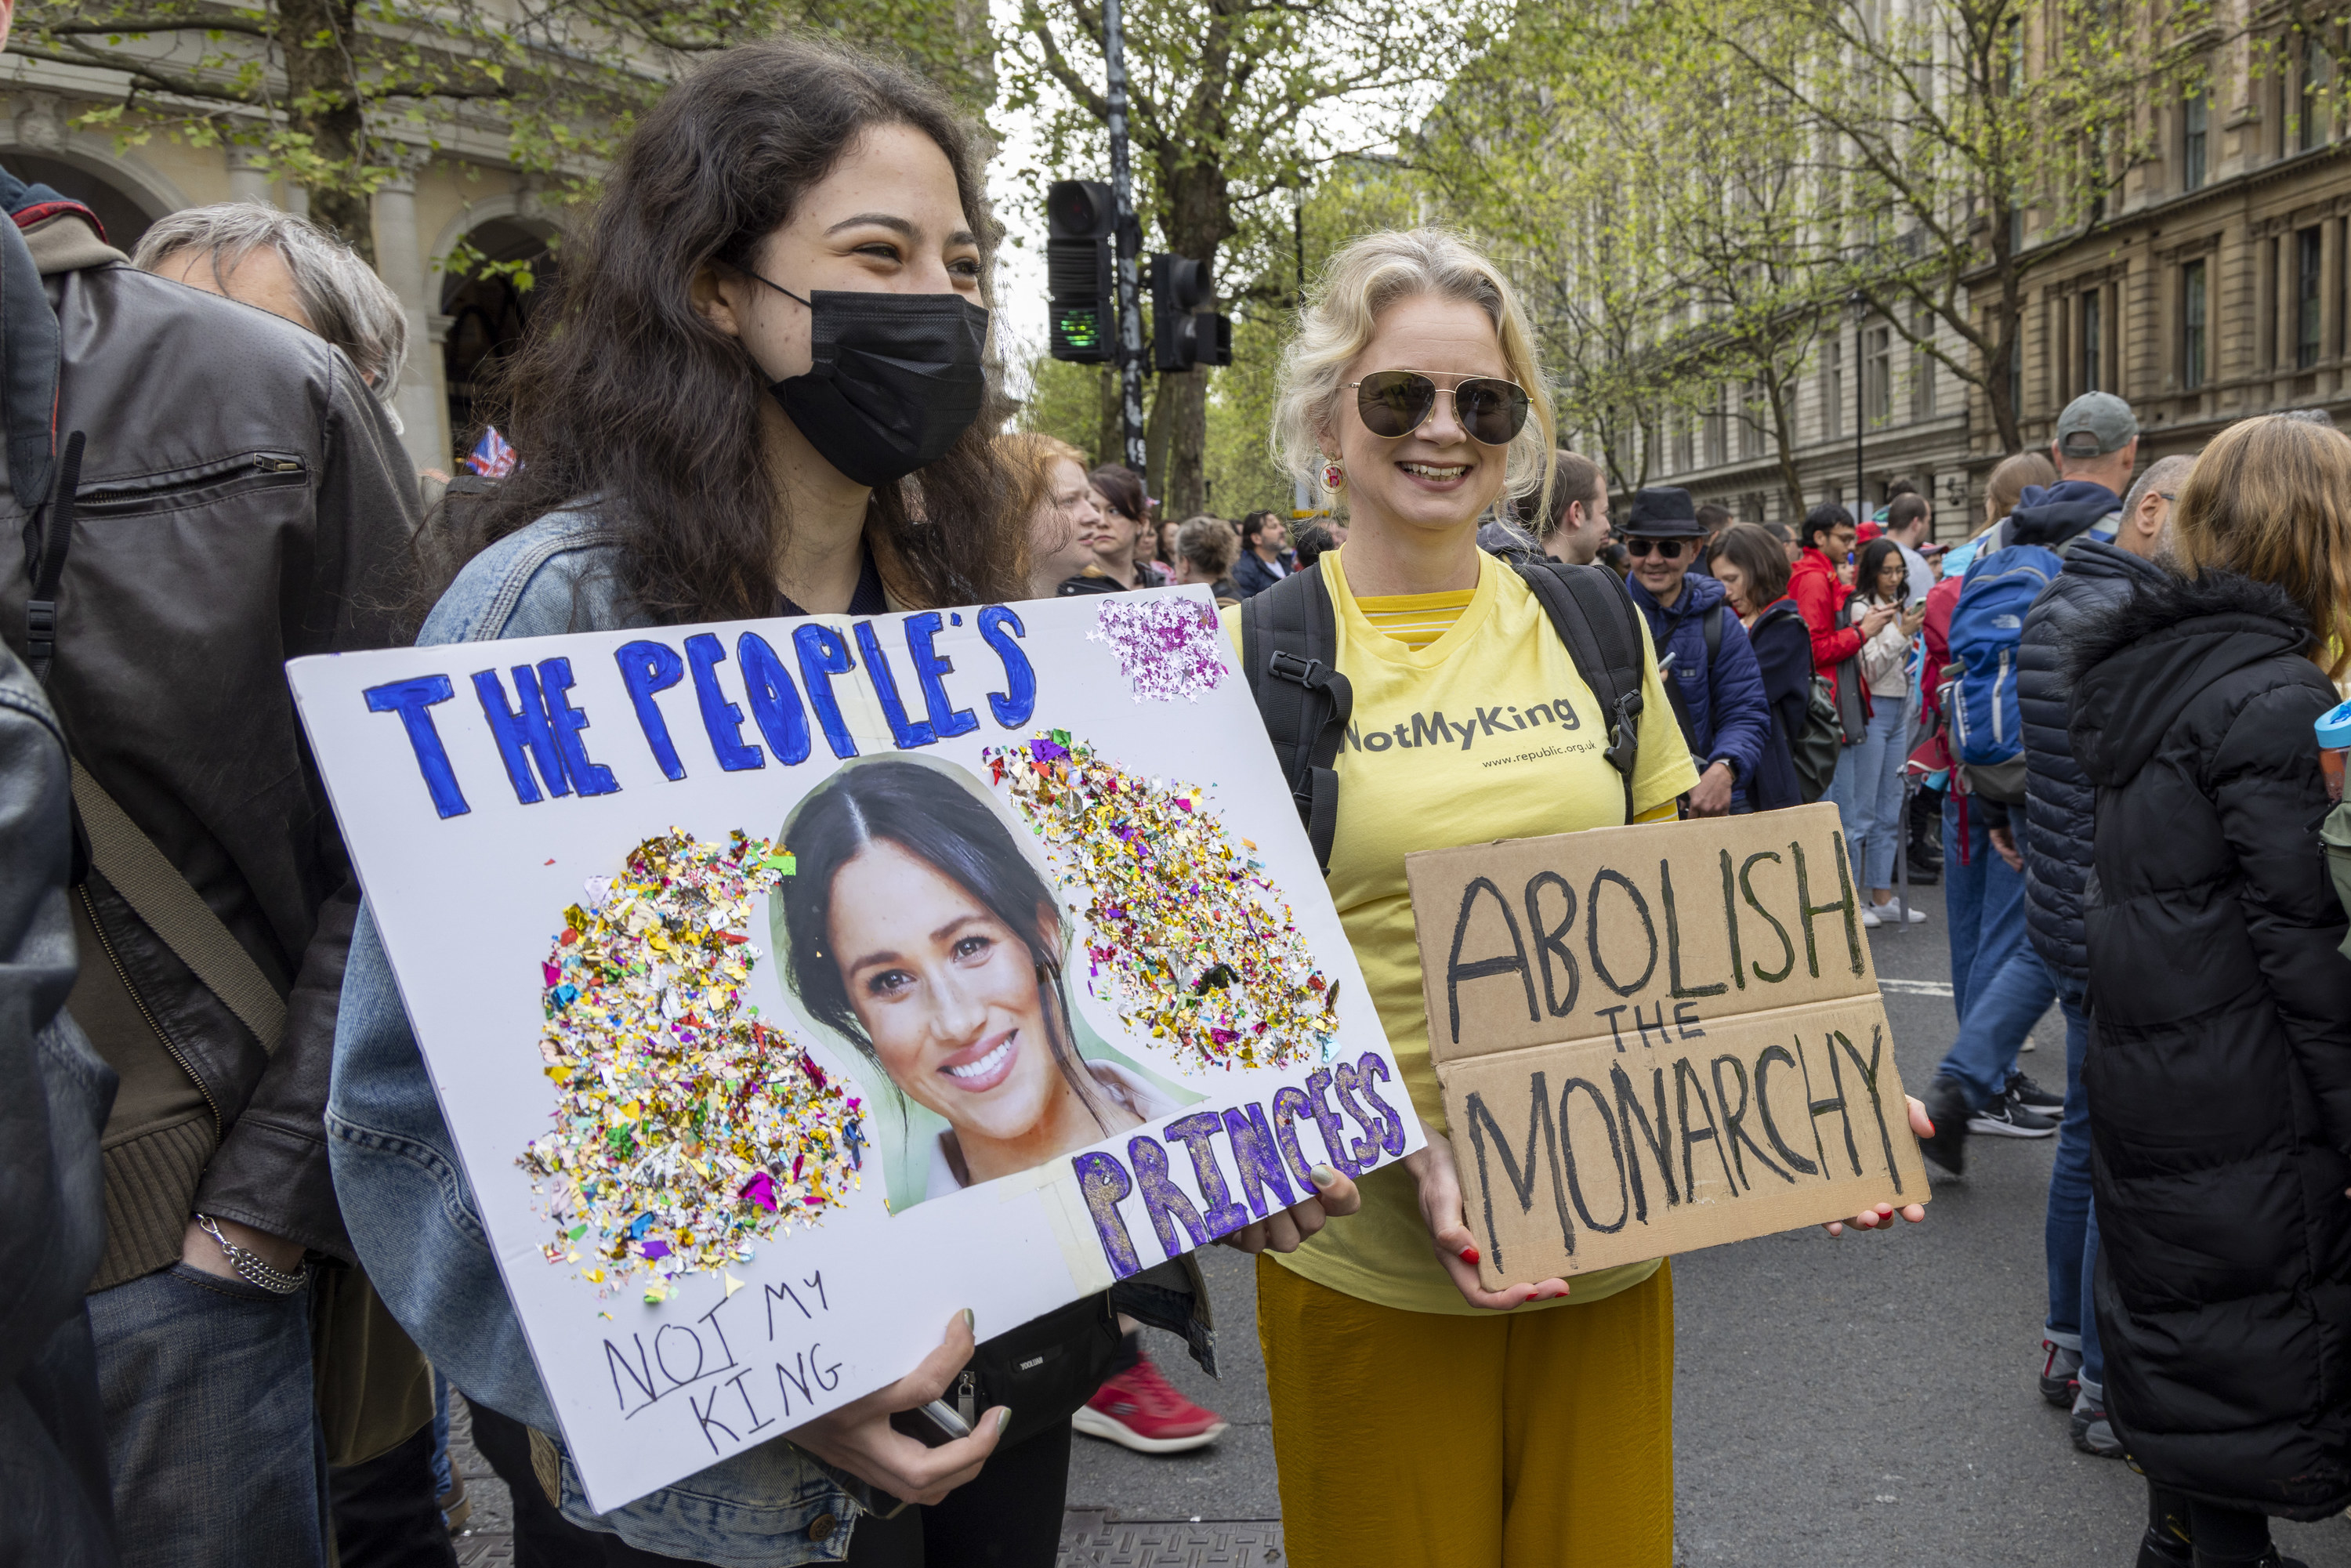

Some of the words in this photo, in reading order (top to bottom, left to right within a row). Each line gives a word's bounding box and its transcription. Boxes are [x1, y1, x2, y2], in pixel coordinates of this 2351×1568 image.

[363, 657, 622, 820] THE
[614, 603, 1037, 781] PEOPLE'S
[1338, 697, 1581, 755] NotMyKing
[1482, 740, 1596, 768] www.republic.org.uk
[1447, 830, 1866, 1045] ABOLISH
[1594, 1000, 1706, 1053] THE
[1071, 1051, 1407, 1282] PRINCESS
[1465, 1023, 1904, 1275] MONARCHY
[603, 1296, 735, 1411] NOT
[765, 1270, 828, 1342] MY
[689, 1342, 843, 1456] KING
